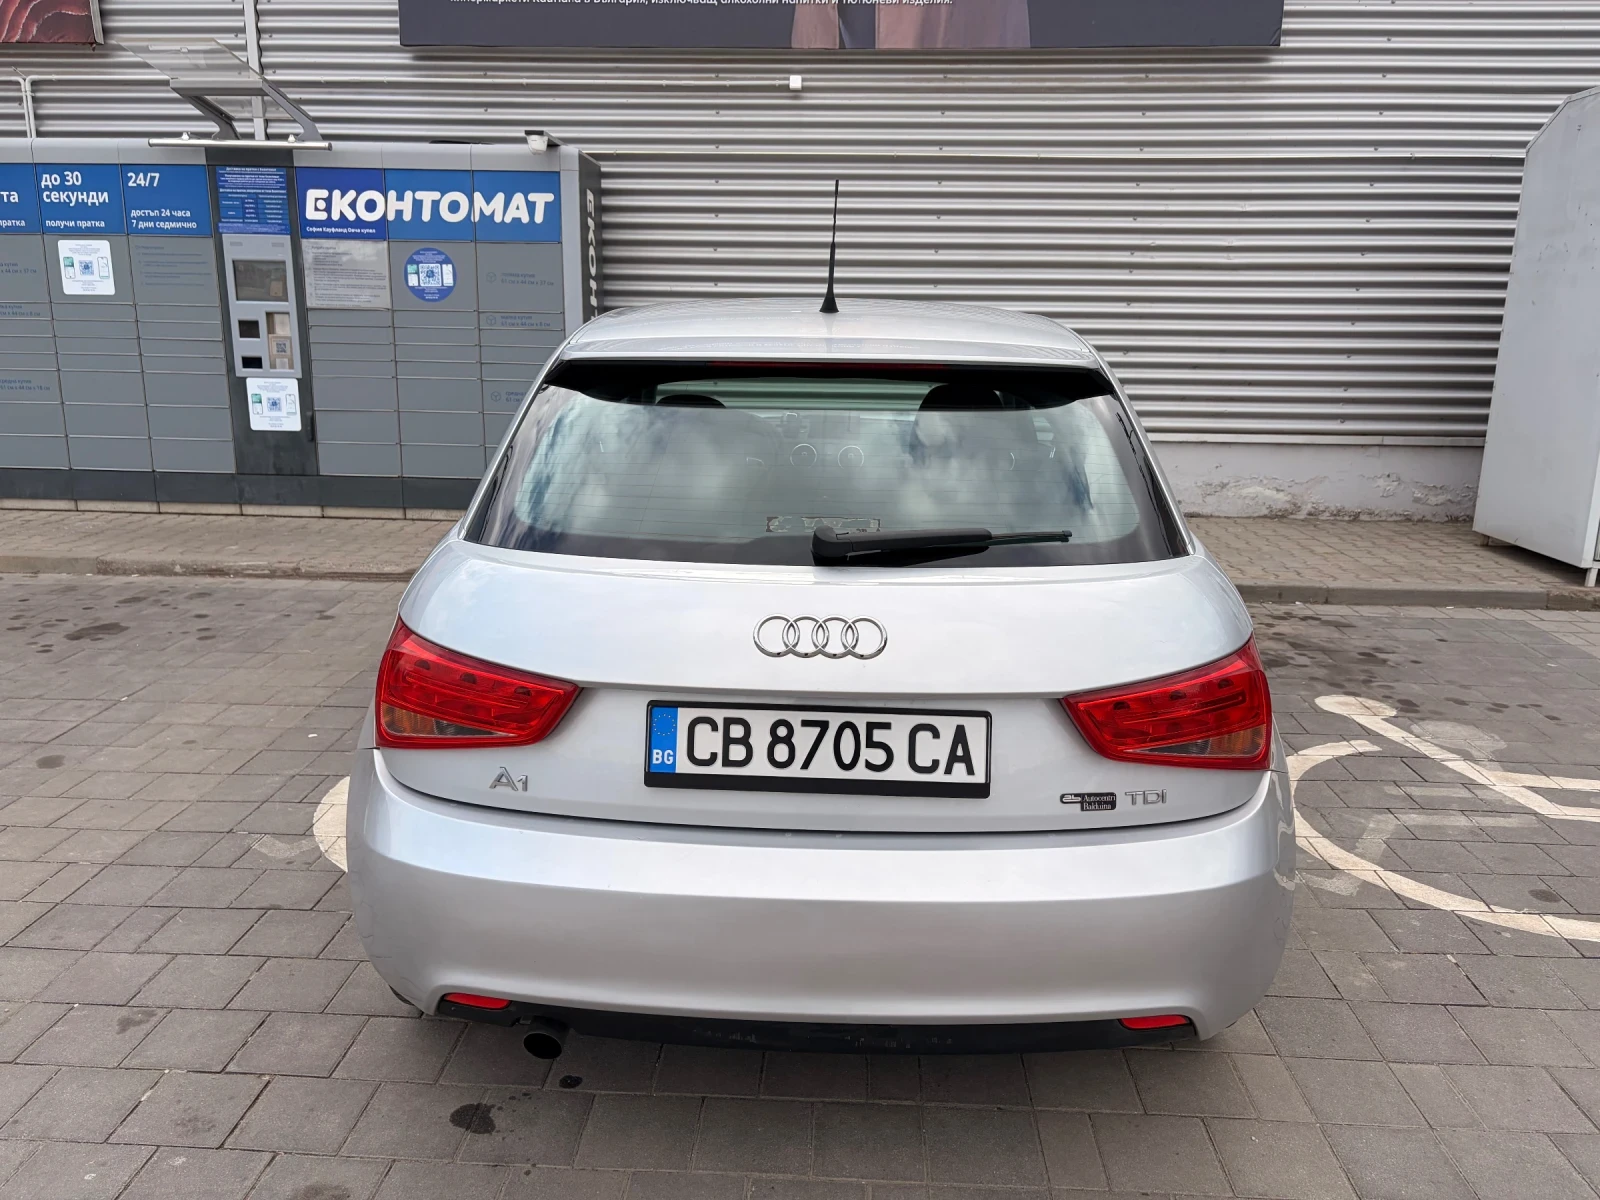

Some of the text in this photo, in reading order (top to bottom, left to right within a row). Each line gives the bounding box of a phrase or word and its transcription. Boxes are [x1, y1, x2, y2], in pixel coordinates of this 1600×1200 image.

[41, 171, 82, 188] до 30
[127, 172, 160, 187] 24/7
[42, 191, 109, 207] секунди
[305, 189, 555, 223] ЕКОНТОМАТ
[131, 209, 159, 217] достъп
[161, 209, 171, 217] 24
[45, 220, 105, 229] получи пратка
[586, 188, 599, 320] ЕКОН
[686, 716, 976, 776] CB 8705 CA
[652, 749, 674, 765] BG
[489, 766, 528, 792] A1
